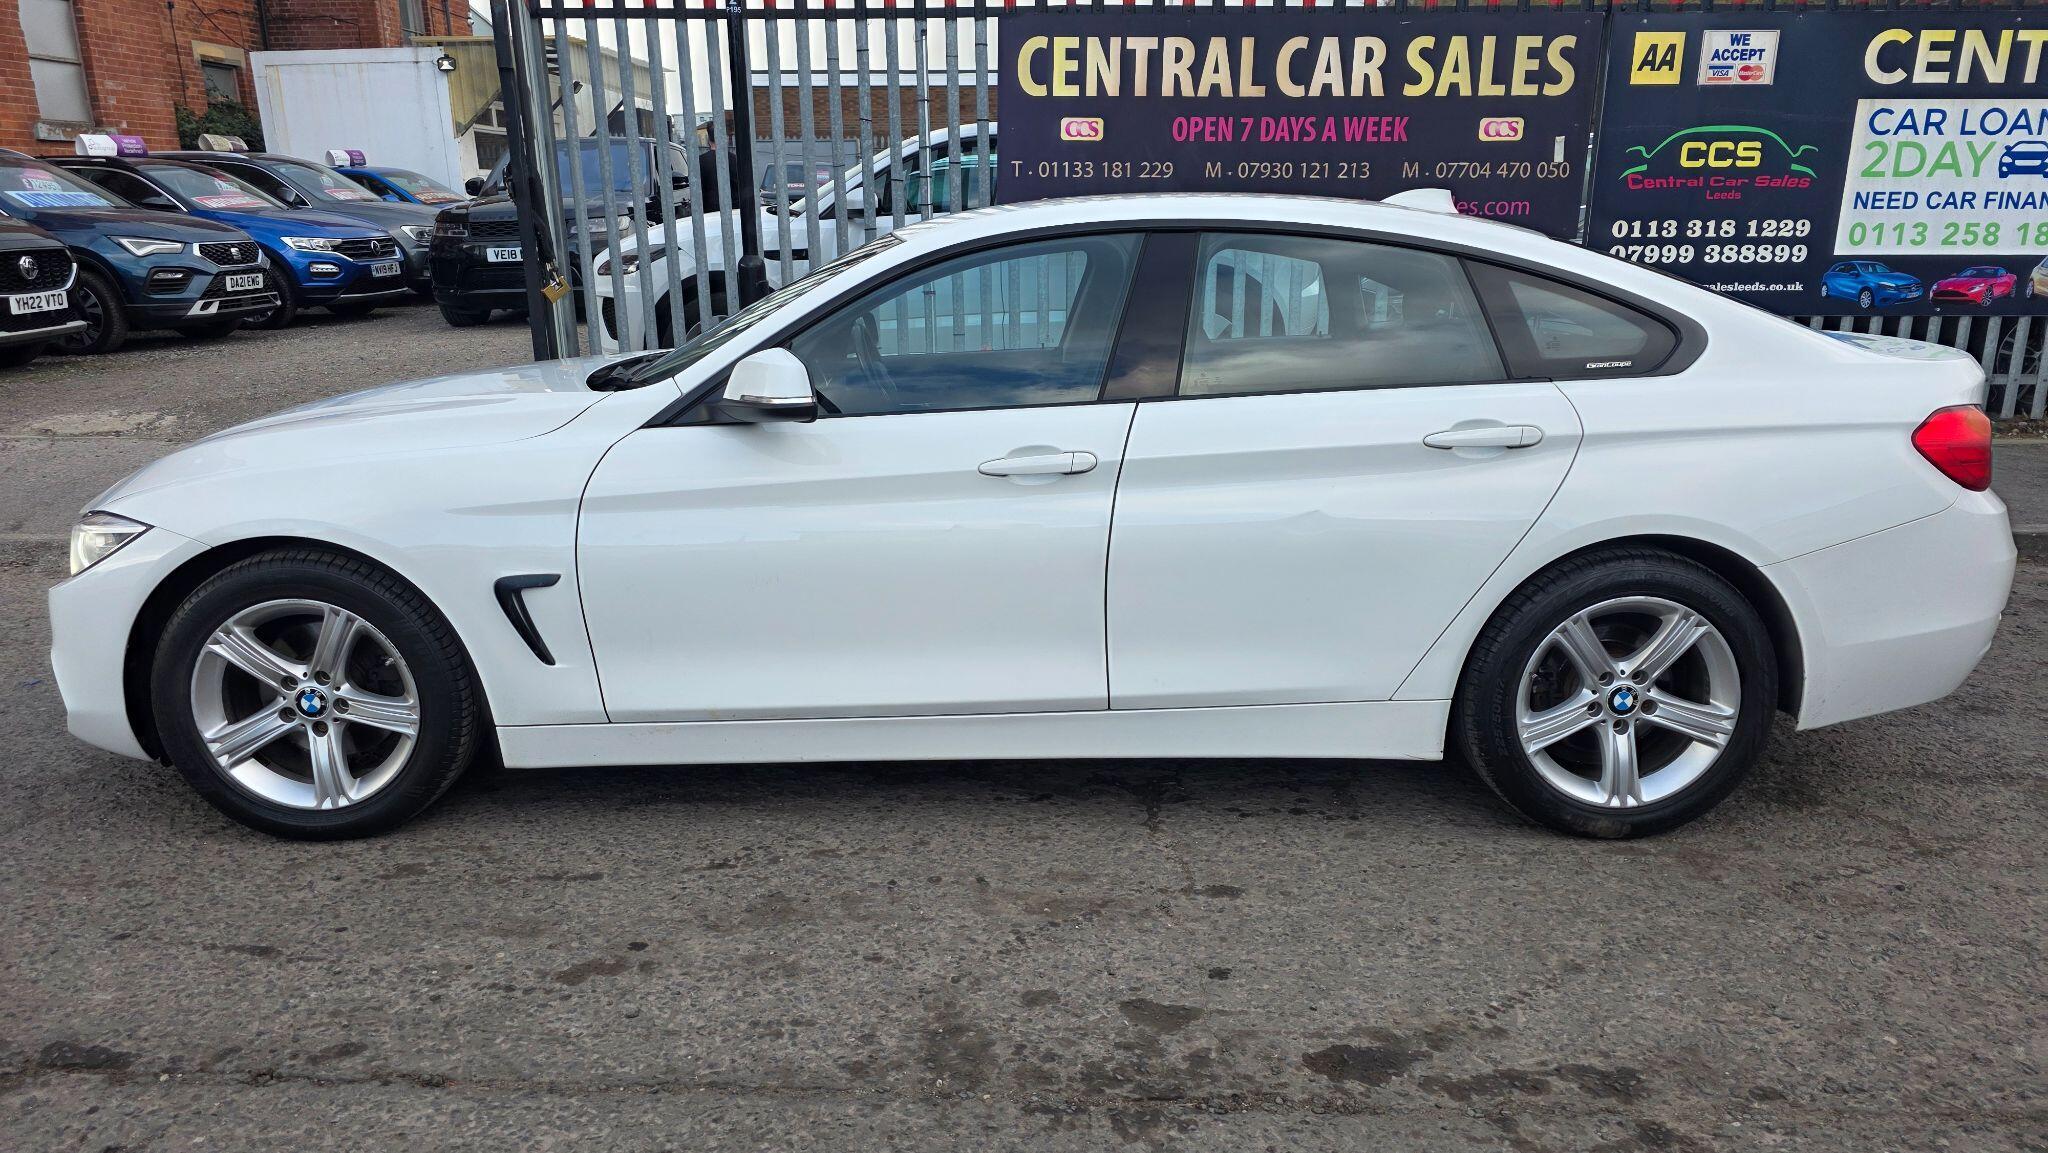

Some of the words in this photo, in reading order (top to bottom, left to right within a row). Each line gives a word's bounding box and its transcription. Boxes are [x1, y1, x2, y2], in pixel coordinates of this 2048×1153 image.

[1730, 34, 1751, 46] WE
[1637, 43, 1677, 72] AA
[1711, 49, 1765, 61] ACCEPT
[1864, 28, 2048, 84] CENT
[1865, 29, 2048, 84] CAR
[1018, 36, 1265, 97] CENTRAL
[1276, 36, 1386, 97] CAR
[1403, 35, 1577, 96] SALES
[1065, 121, 1099, 137] CCS
[1173, 117, 1233, 141] OPEN
[1241, 118, 1253, 141] 7
[1260, 117, 1316, 141] DAYS
[1321, 117, 1336, 141] A
[1344, 117, 1409, 141] WEEK
[1484, 121, 1519, 137] CCS
[1680, 141, 1761, 167] CCS
[1861, 140, 1997, 178] 2DAY
[1861, 141, 2000, 178] NEED
[1011, 161, 1023, 177] T
[1039, 162, 1093, 177] 01133
[1103, 162, 1130, 178] 181
[1139, 162, 1173, 178] 229
[1206, 162, 1221, 178] M
[1238, 162, 1292, 178] 07930
[1301, 163, 1328, 178] 121
[1338, 162, 1369, 178] 213
[1403, 162, 1418, 178] M
[1436, 162, 1491, 178] 07704
[1497, 162, 1530, 178] 470
[1537, 162, 1569, 178] 050
[1628, 174, 1703, 189] Central
[1710, 176, 1749, 186] Car
[1754, 174, 1812, 188] Sales
[1706, 190, 1741, 199] Leeds
[1853, 192, 1918, 209] CAR
[1984, 192, 2048, 209] 0113
[1612, 220, 1677, 238] 0113
[1687, 220, 1735, 237] 318
[1747, 219, 1810, 237] 1229
[1849, 222, 1928, 246] 258
[493, 249, 517, 260] VE18
[1704, 245, 1807, 263] 388899
[15, 296, 43, 311] YH22
[44, 293, 64, 308] VTO
